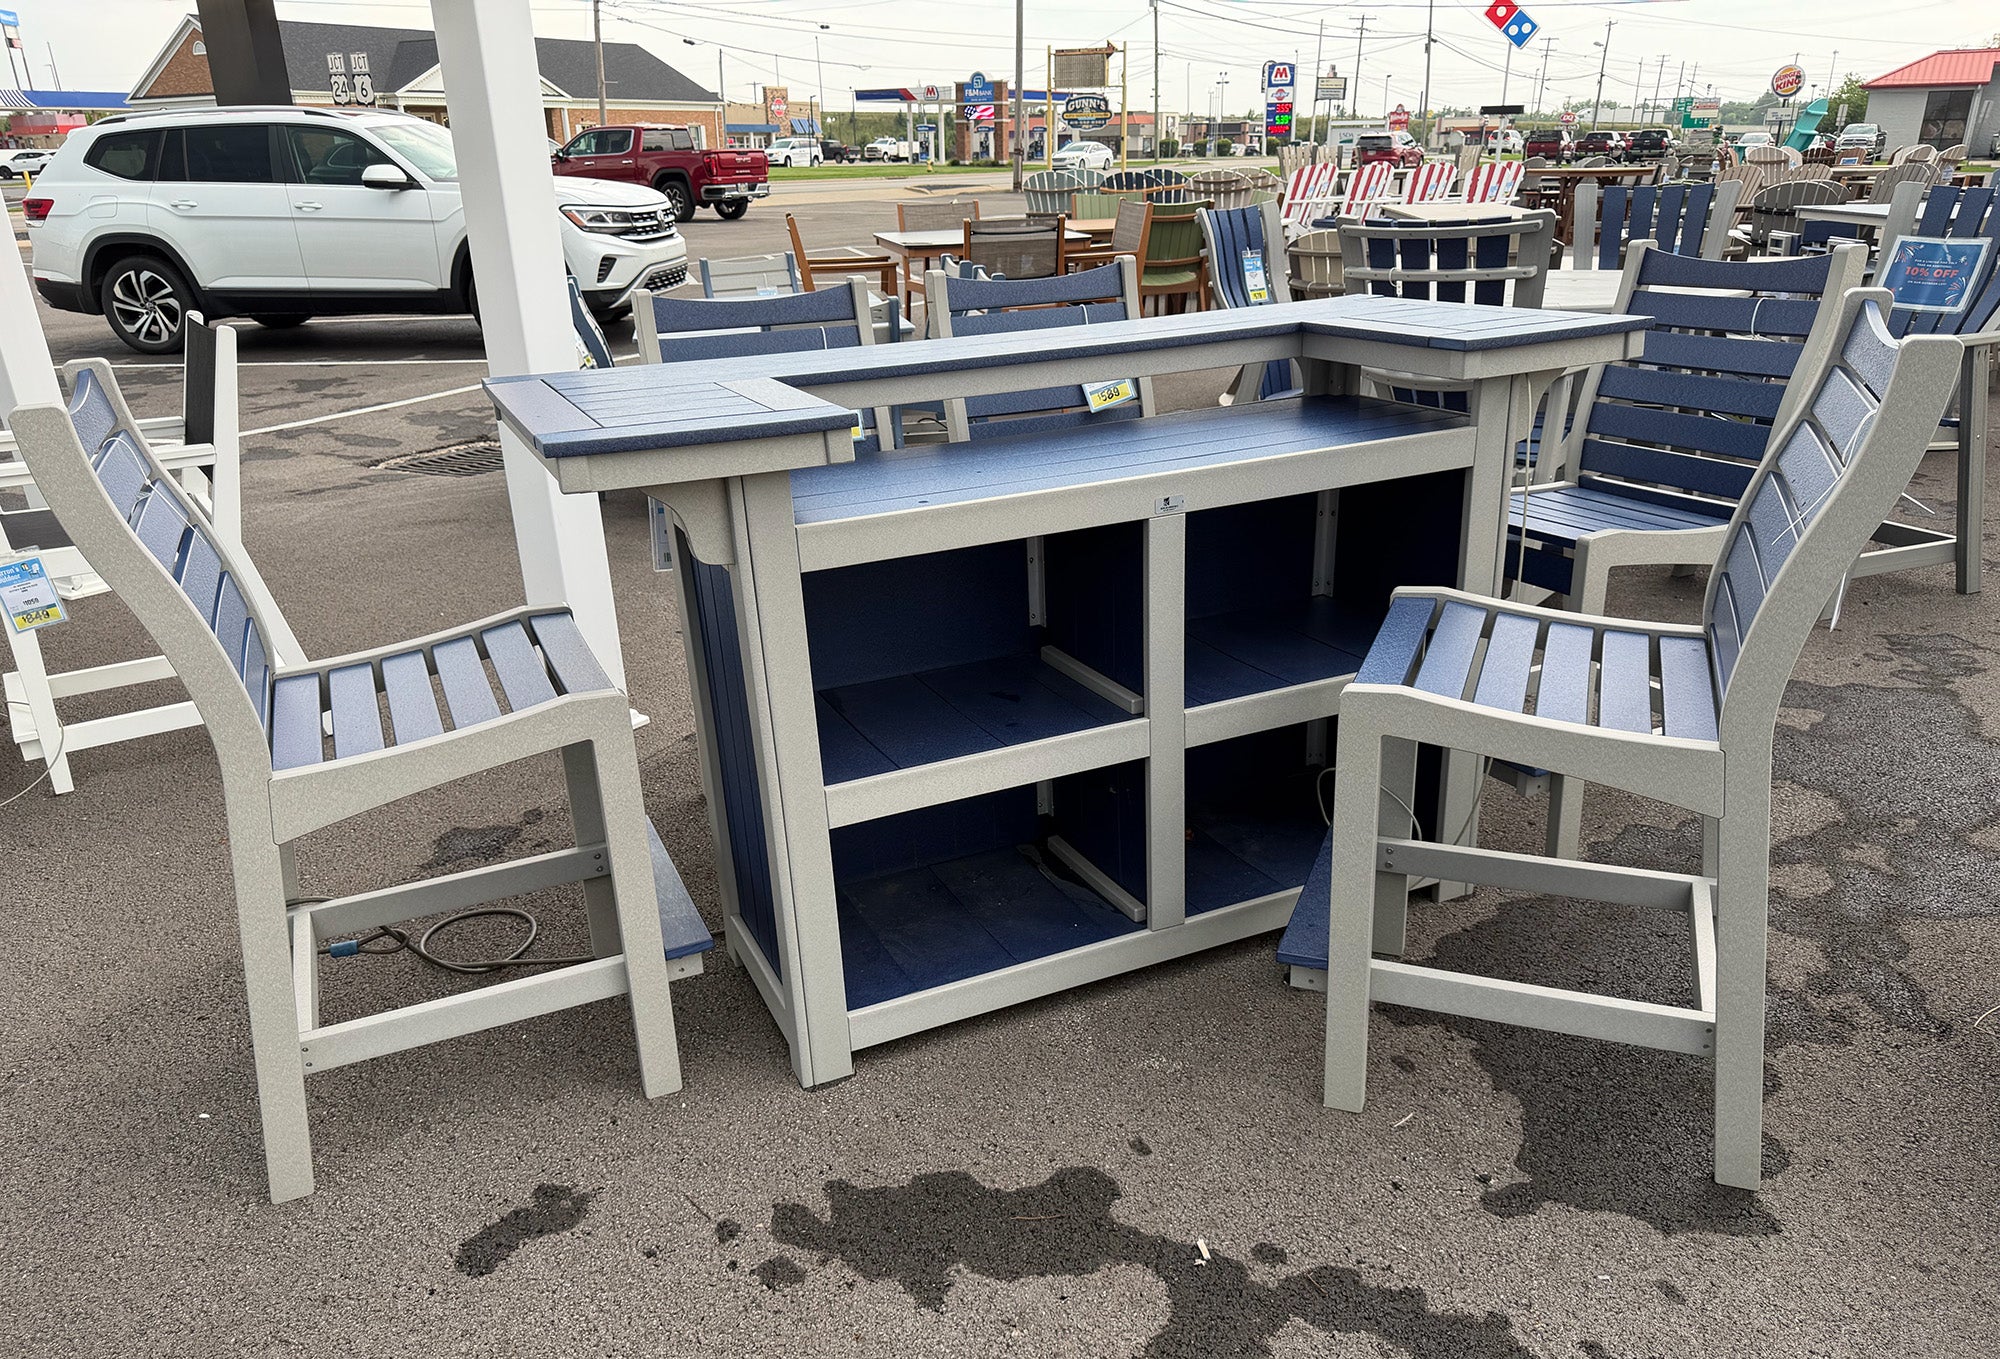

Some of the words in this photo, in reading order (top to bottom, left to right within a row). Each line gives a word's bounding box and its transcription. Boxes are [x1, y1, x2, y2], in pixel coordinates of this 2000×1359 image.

[330, 56, 343, 70] JCT
[353, 56, 367, 70] JCT
[1775, 70, 1801, 83] BURGER
[333, 80, 348, 97] 24
[361, 81, 368, 98] 6
[1776, 78, 1802, 92] KING
[1068, 98, 1106, 111] GUNN'S
[1905, 266, 1929, 276] 10%
[1933, 269, 1959, 278] OFF
